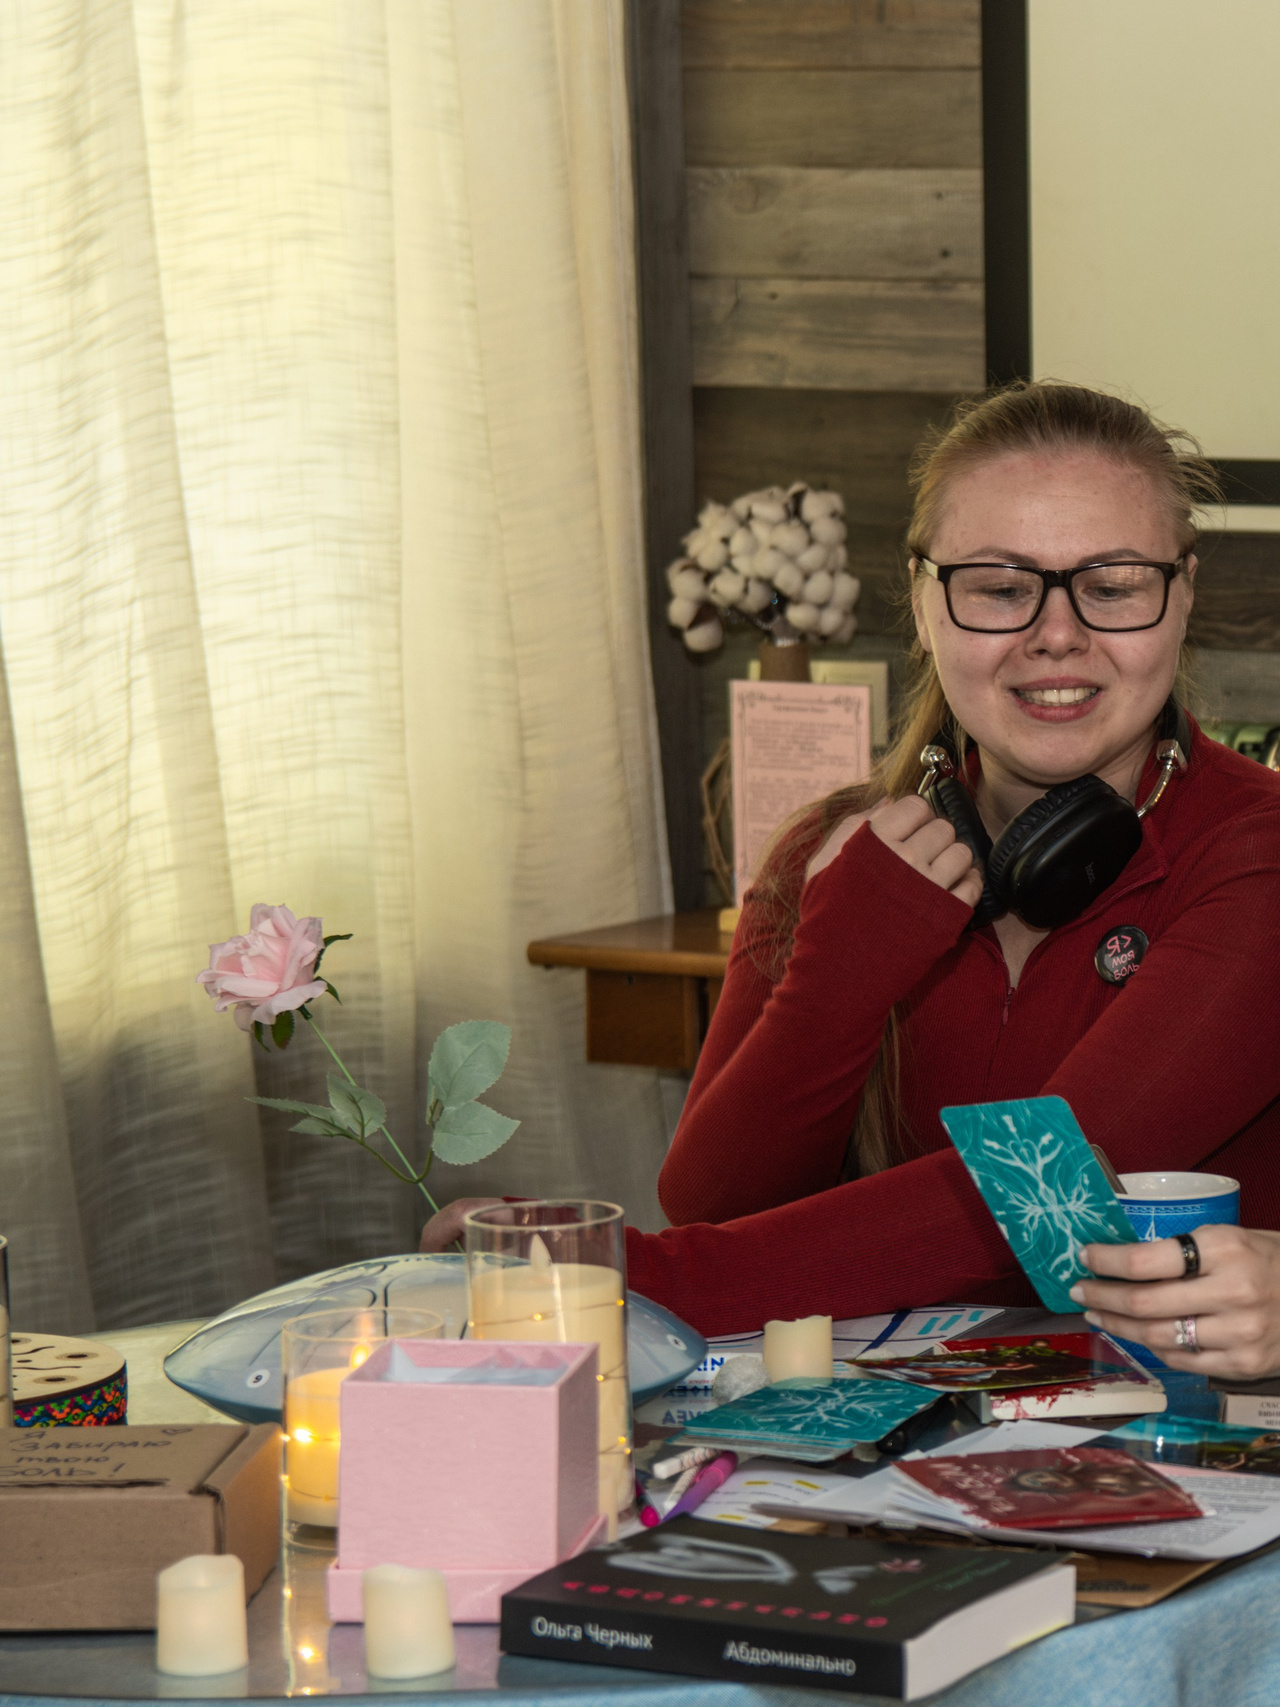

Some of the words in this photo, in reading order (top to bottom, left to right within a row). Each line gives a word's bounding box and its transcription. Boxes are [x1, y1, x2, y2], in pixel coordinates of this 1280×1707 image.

[531, 1615, 582, 1641] Ольга
[583, 1621, 654, 1651] Черных
[722, 1639, 857, 1677] Абдоминально
